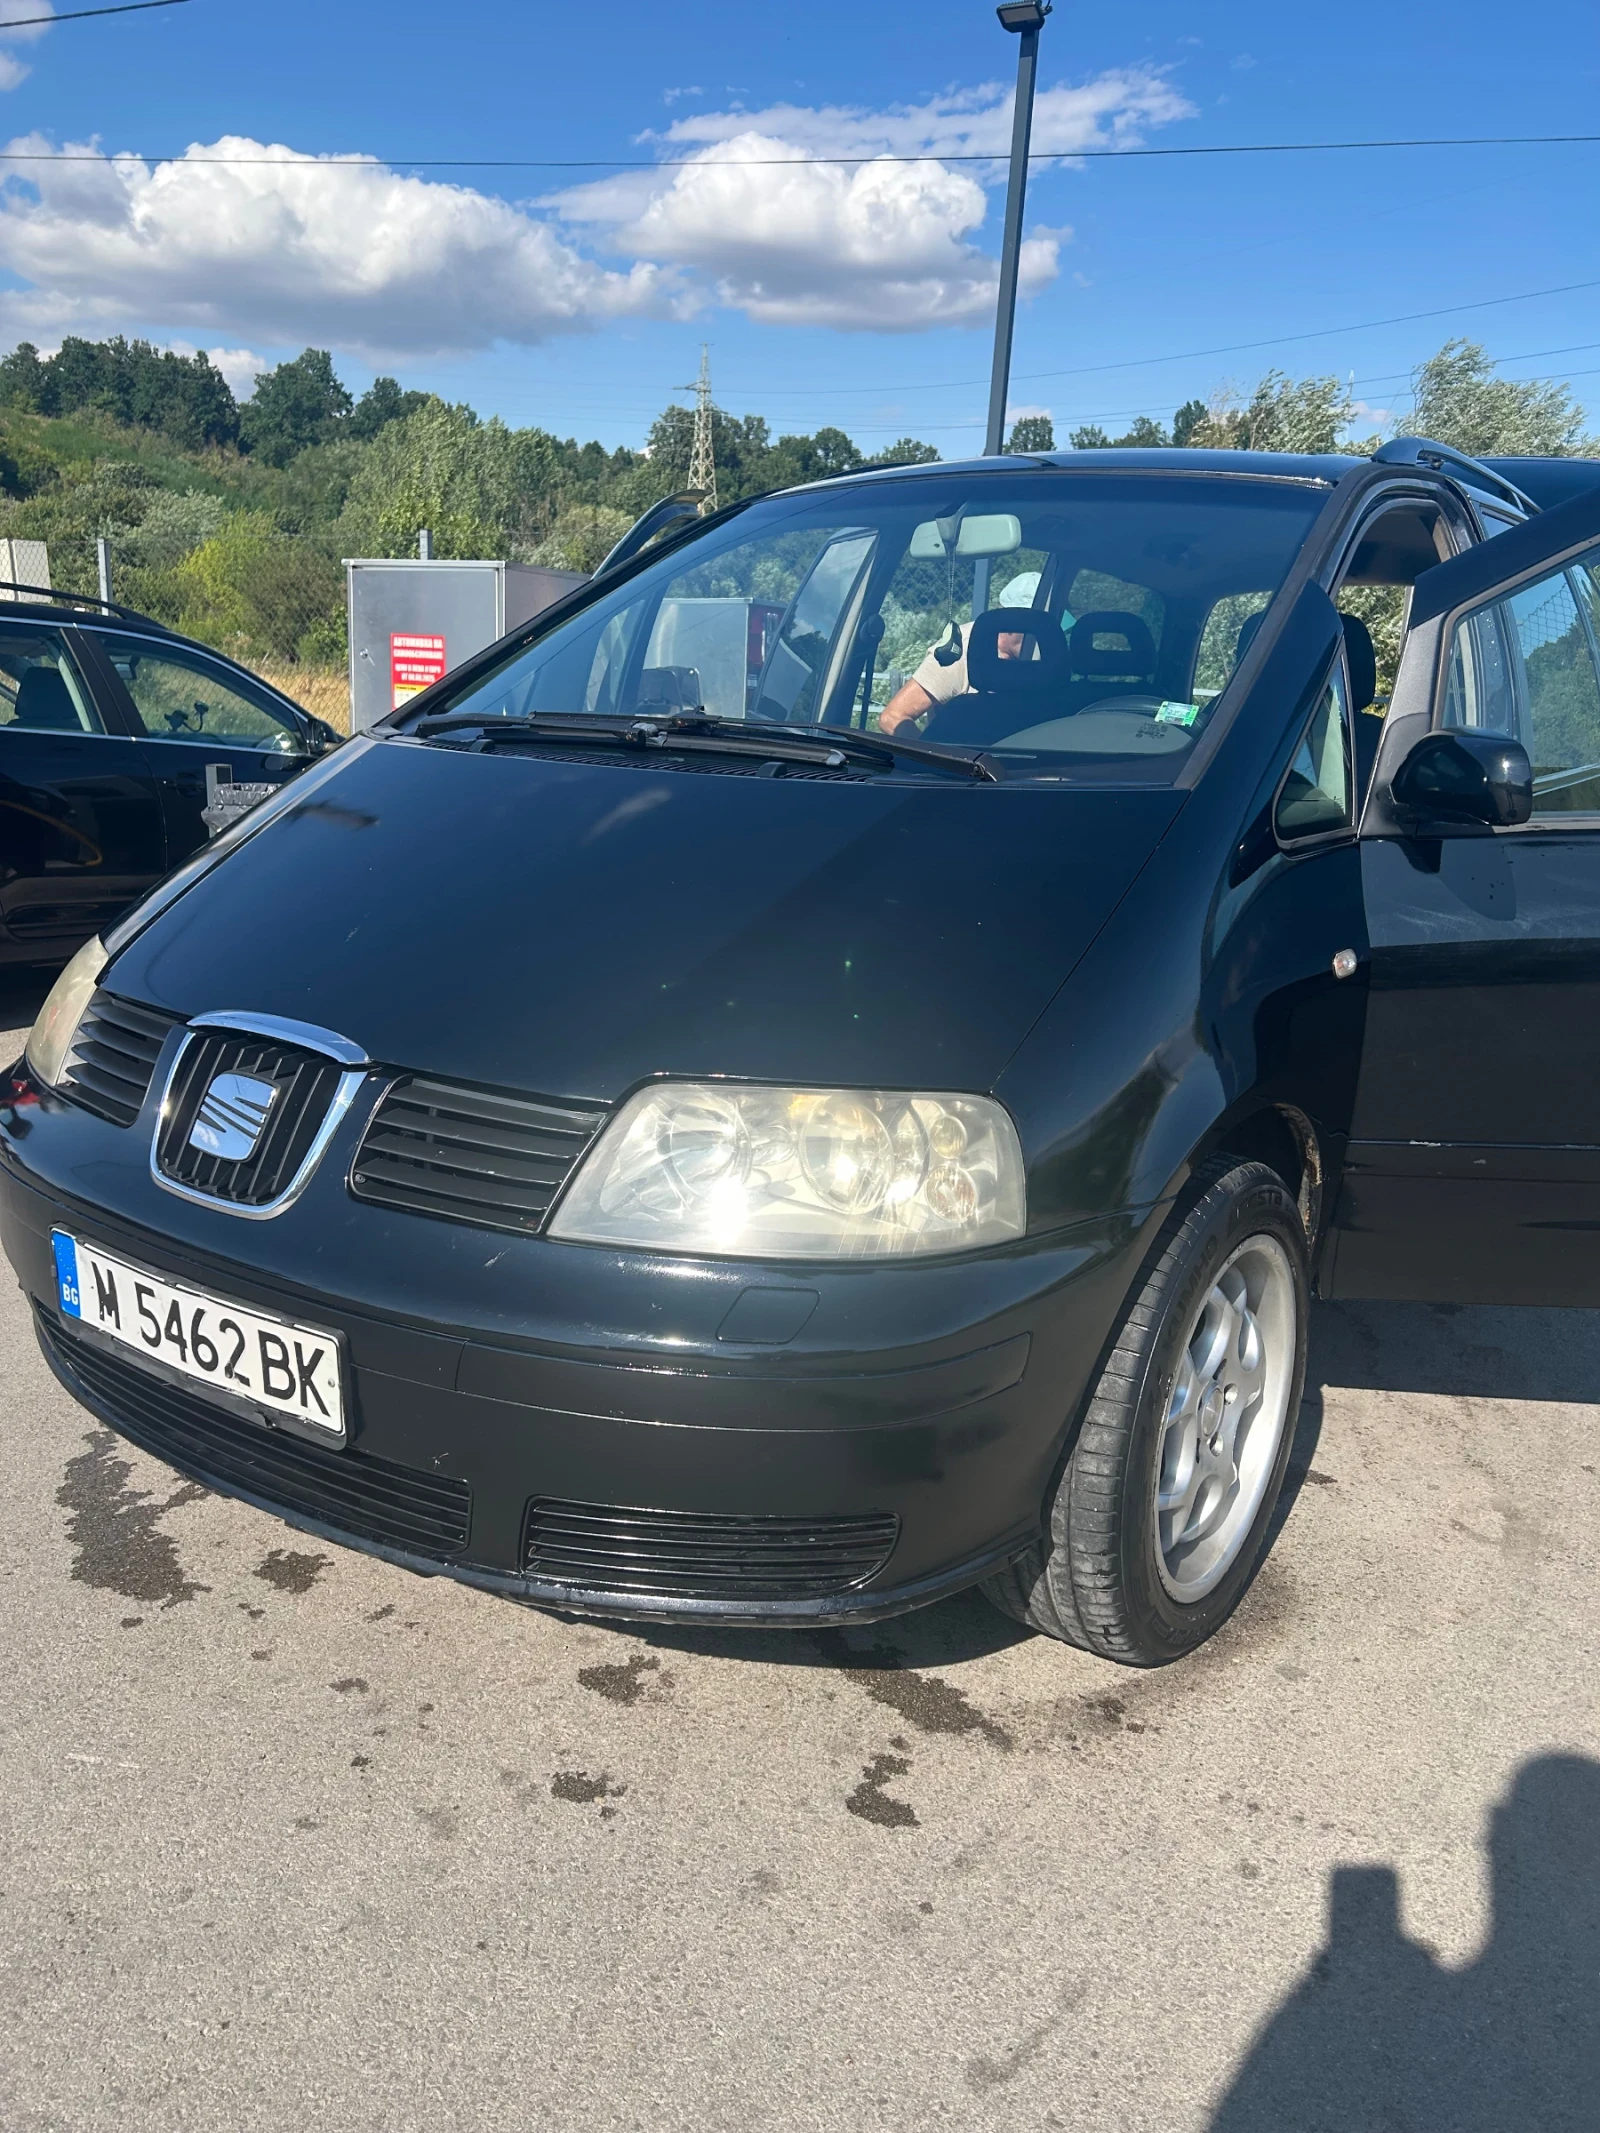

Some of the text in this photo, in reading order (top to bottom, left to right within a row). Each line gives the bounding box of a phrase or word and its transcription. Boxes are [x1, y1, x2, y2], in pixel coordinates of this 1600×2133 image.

[62, 1282, 79, 1306] BG
[91, 1260, 332, 1418] M 5462 BK
